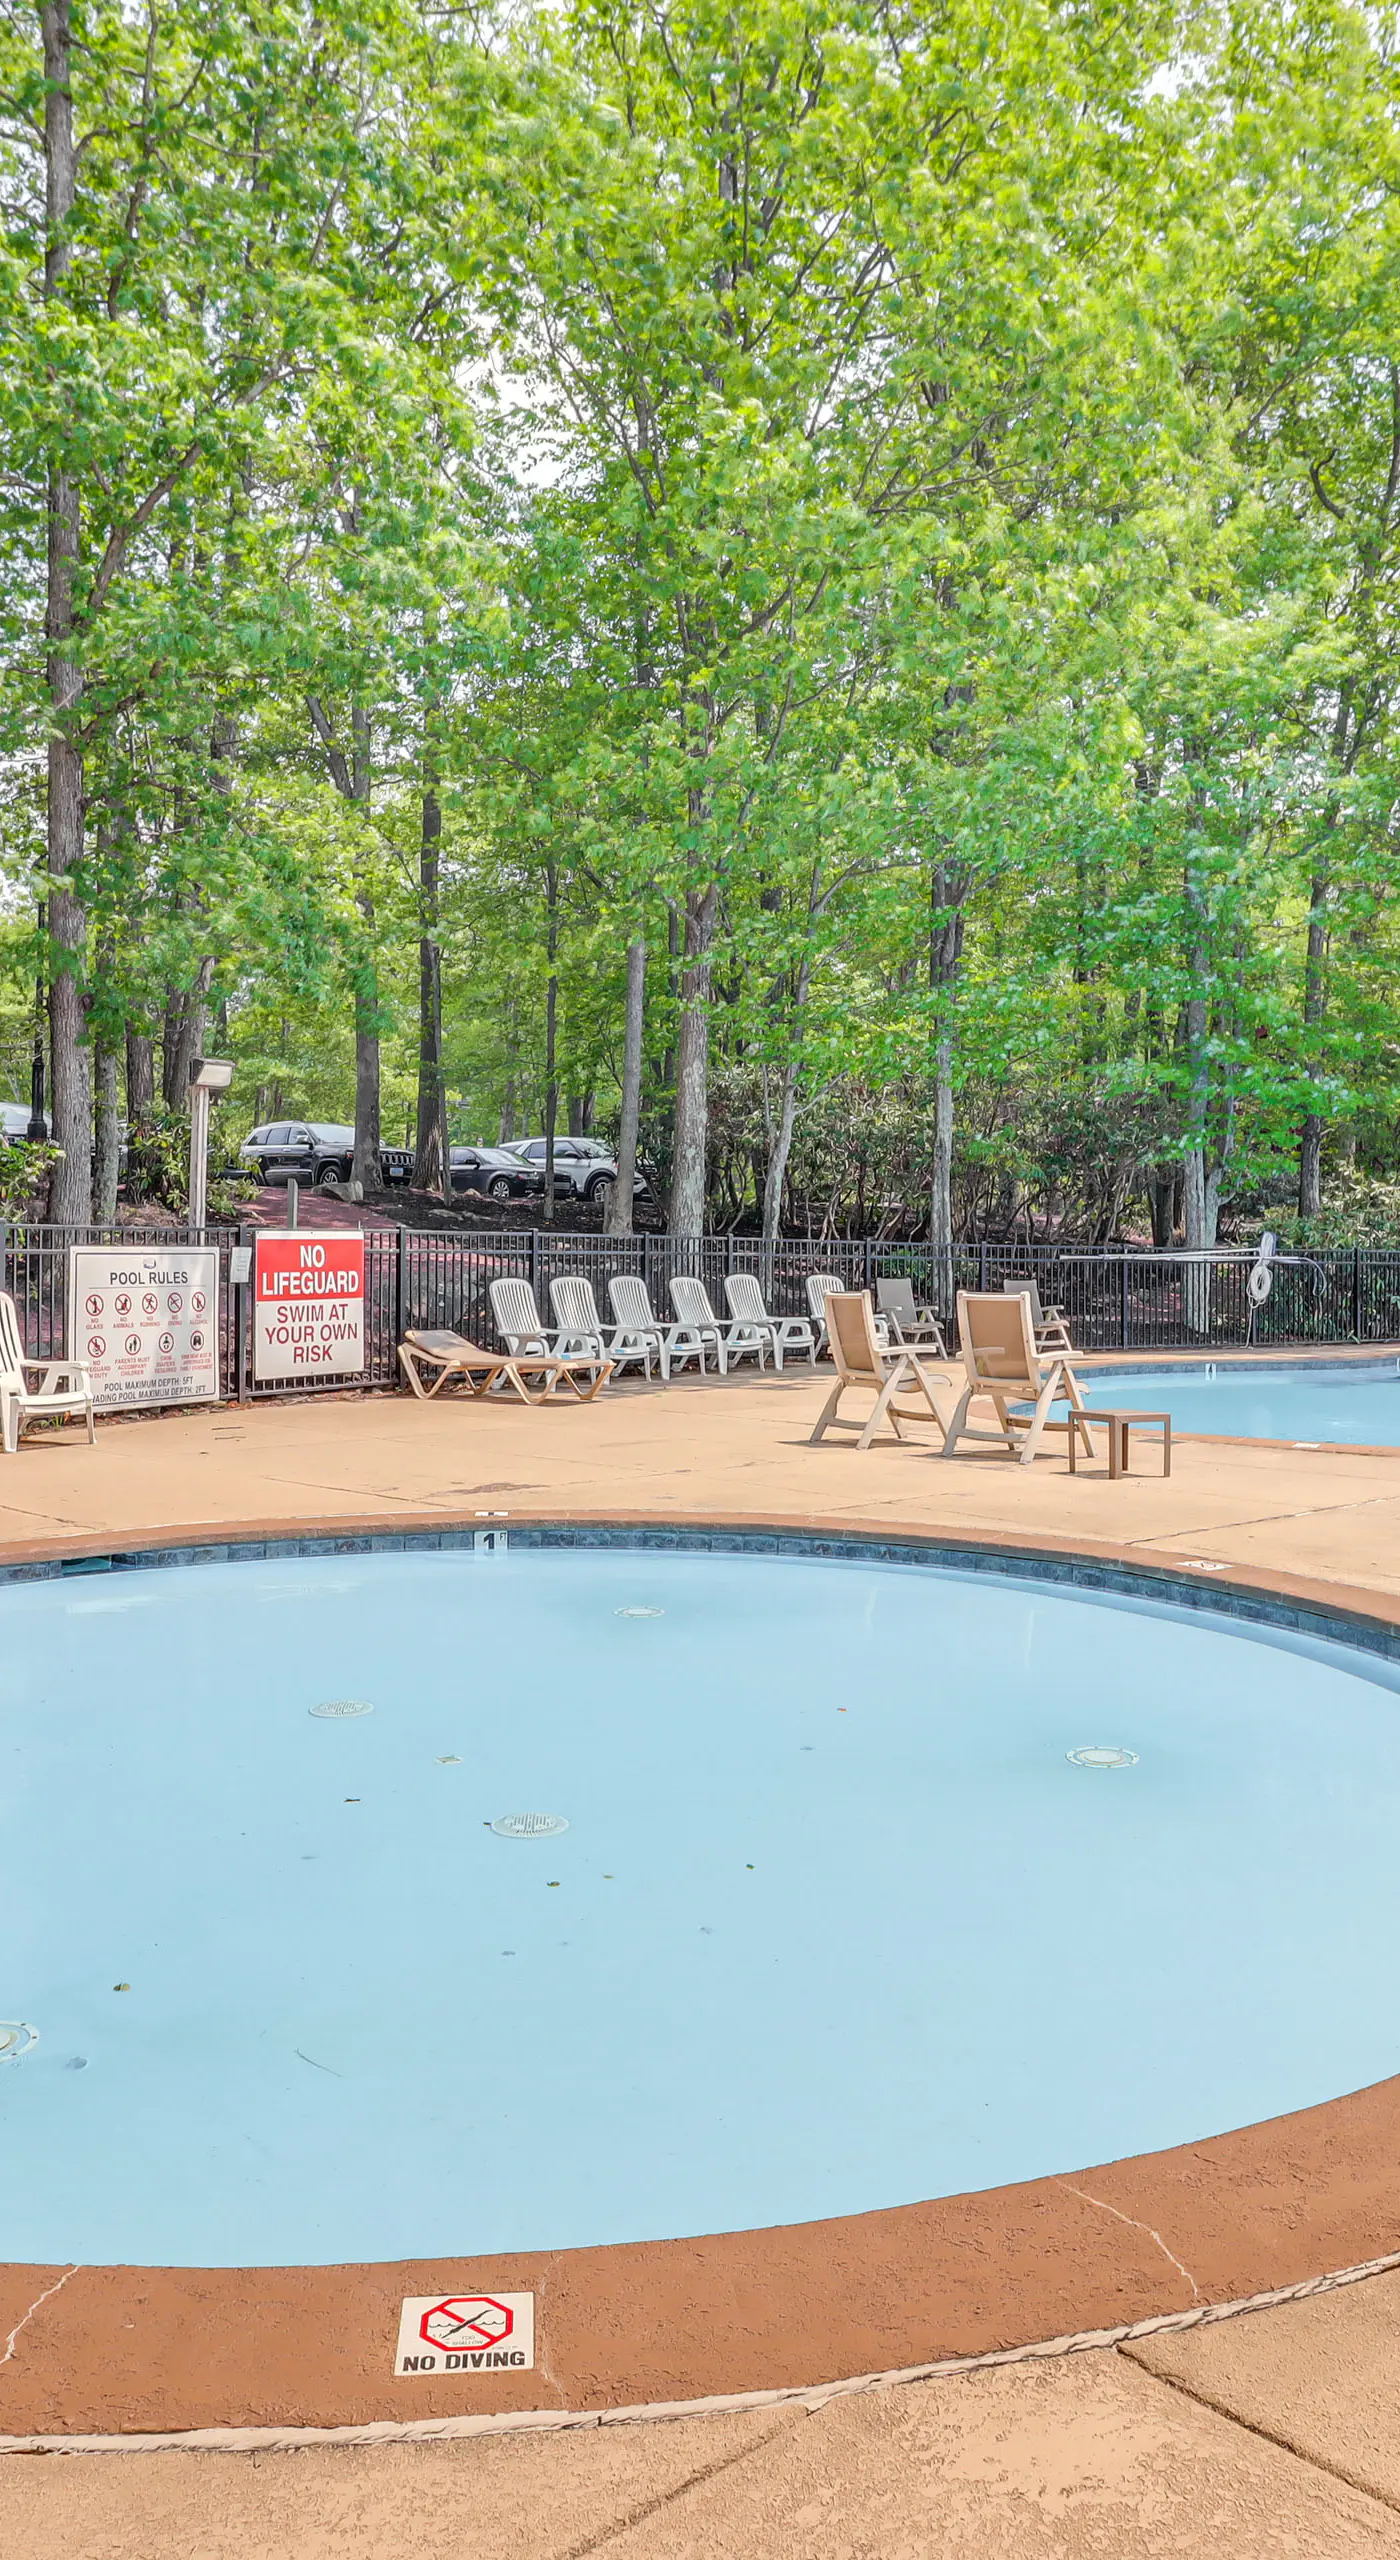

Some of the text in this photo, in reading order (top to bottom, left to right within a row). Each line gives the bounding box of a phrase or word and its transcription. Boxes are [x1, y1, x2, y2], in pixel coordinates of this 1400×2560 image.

[300, 1245, 326, 1268] NO
[110, 1271, 188, 1285] POOL RULES
[262, 1271, 359, 1295] LIFEGUARD
[277, 1303, 349, 1323] SWIM AT
[265, 1323, 358, 1345] YOUR OWN
[293, 1344, 333, 1363] RISK
[104, 1376, 193, 1392] POOL MAXIMUM DEPTH: 5FT
[118, 1392, 136, 1402] POOL
[138, 1388, 170, 1398] MAXIMUM
[171, 1386, 194, 1396] DEPTH:
[196, 1385, 206, 1394] 2FT
[403, 2352, 525, 2372] NO DIVING
